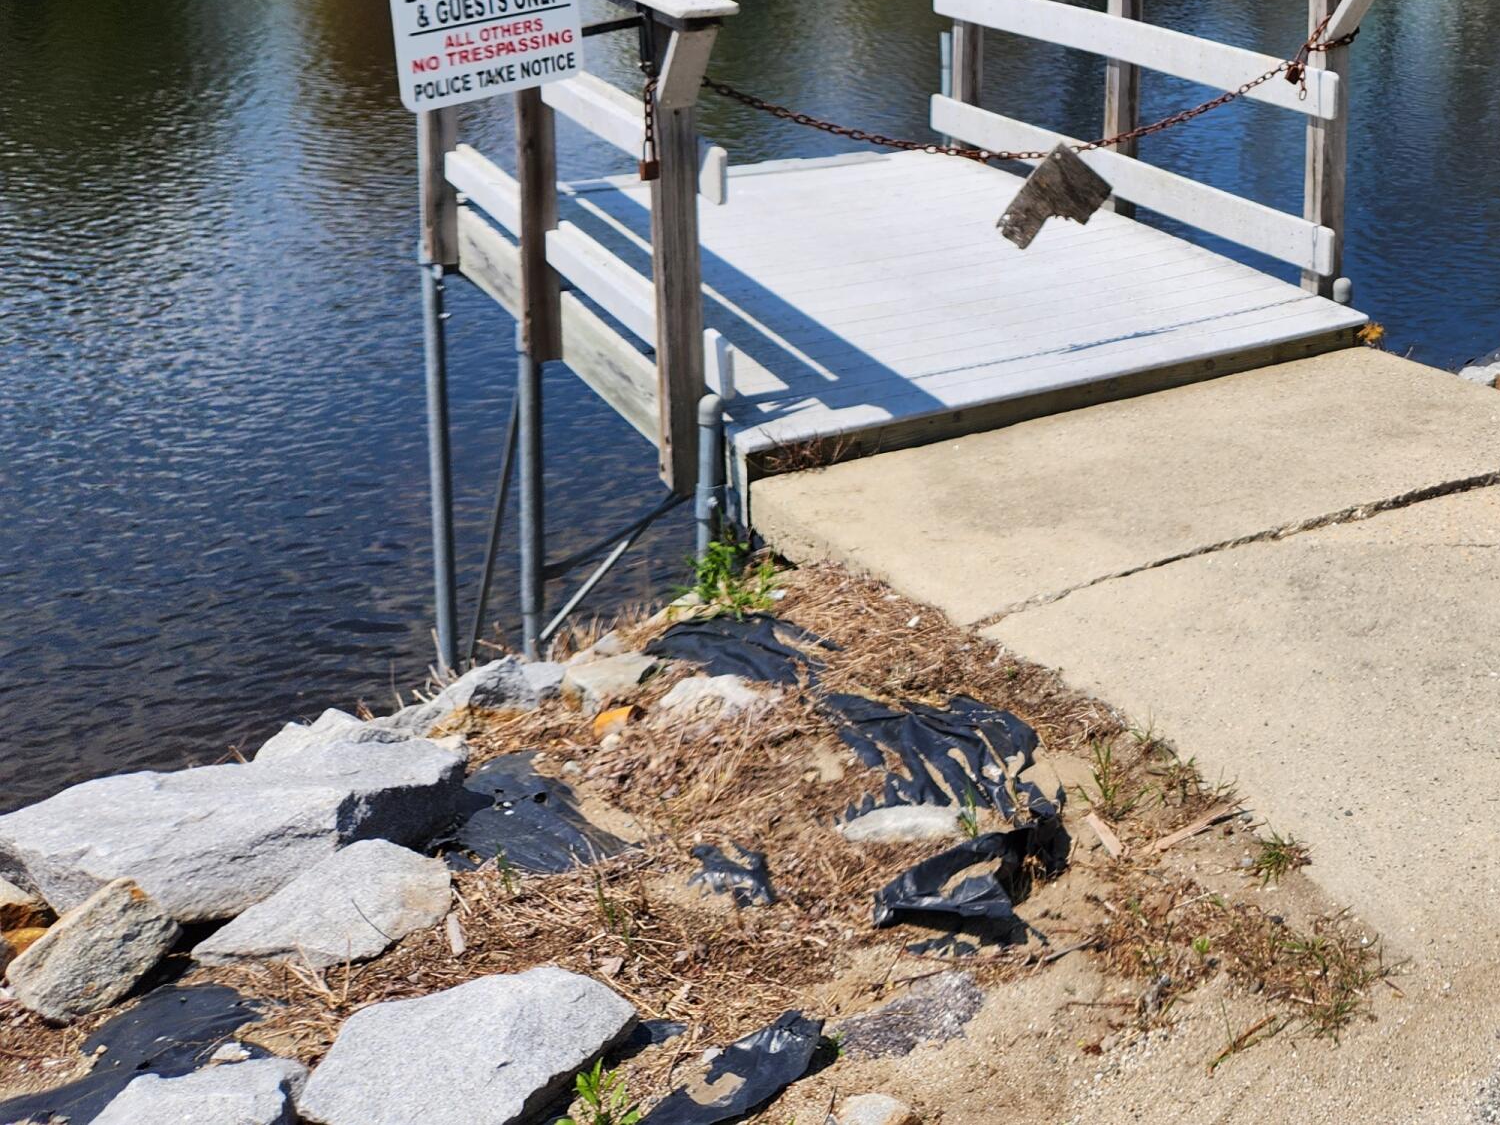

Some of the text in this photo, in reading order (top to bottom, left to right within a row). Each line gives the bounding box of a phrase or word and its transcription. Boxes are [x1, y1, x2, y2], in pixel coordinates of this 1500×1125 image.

[417, 4, 430, 28] &
[444, 18, 544, 50] ALL OTHERS
[412, 29, 574, 74] NO TRESPASSING
[414, 52, 576, 102] POLICE TAKE NOTICE
